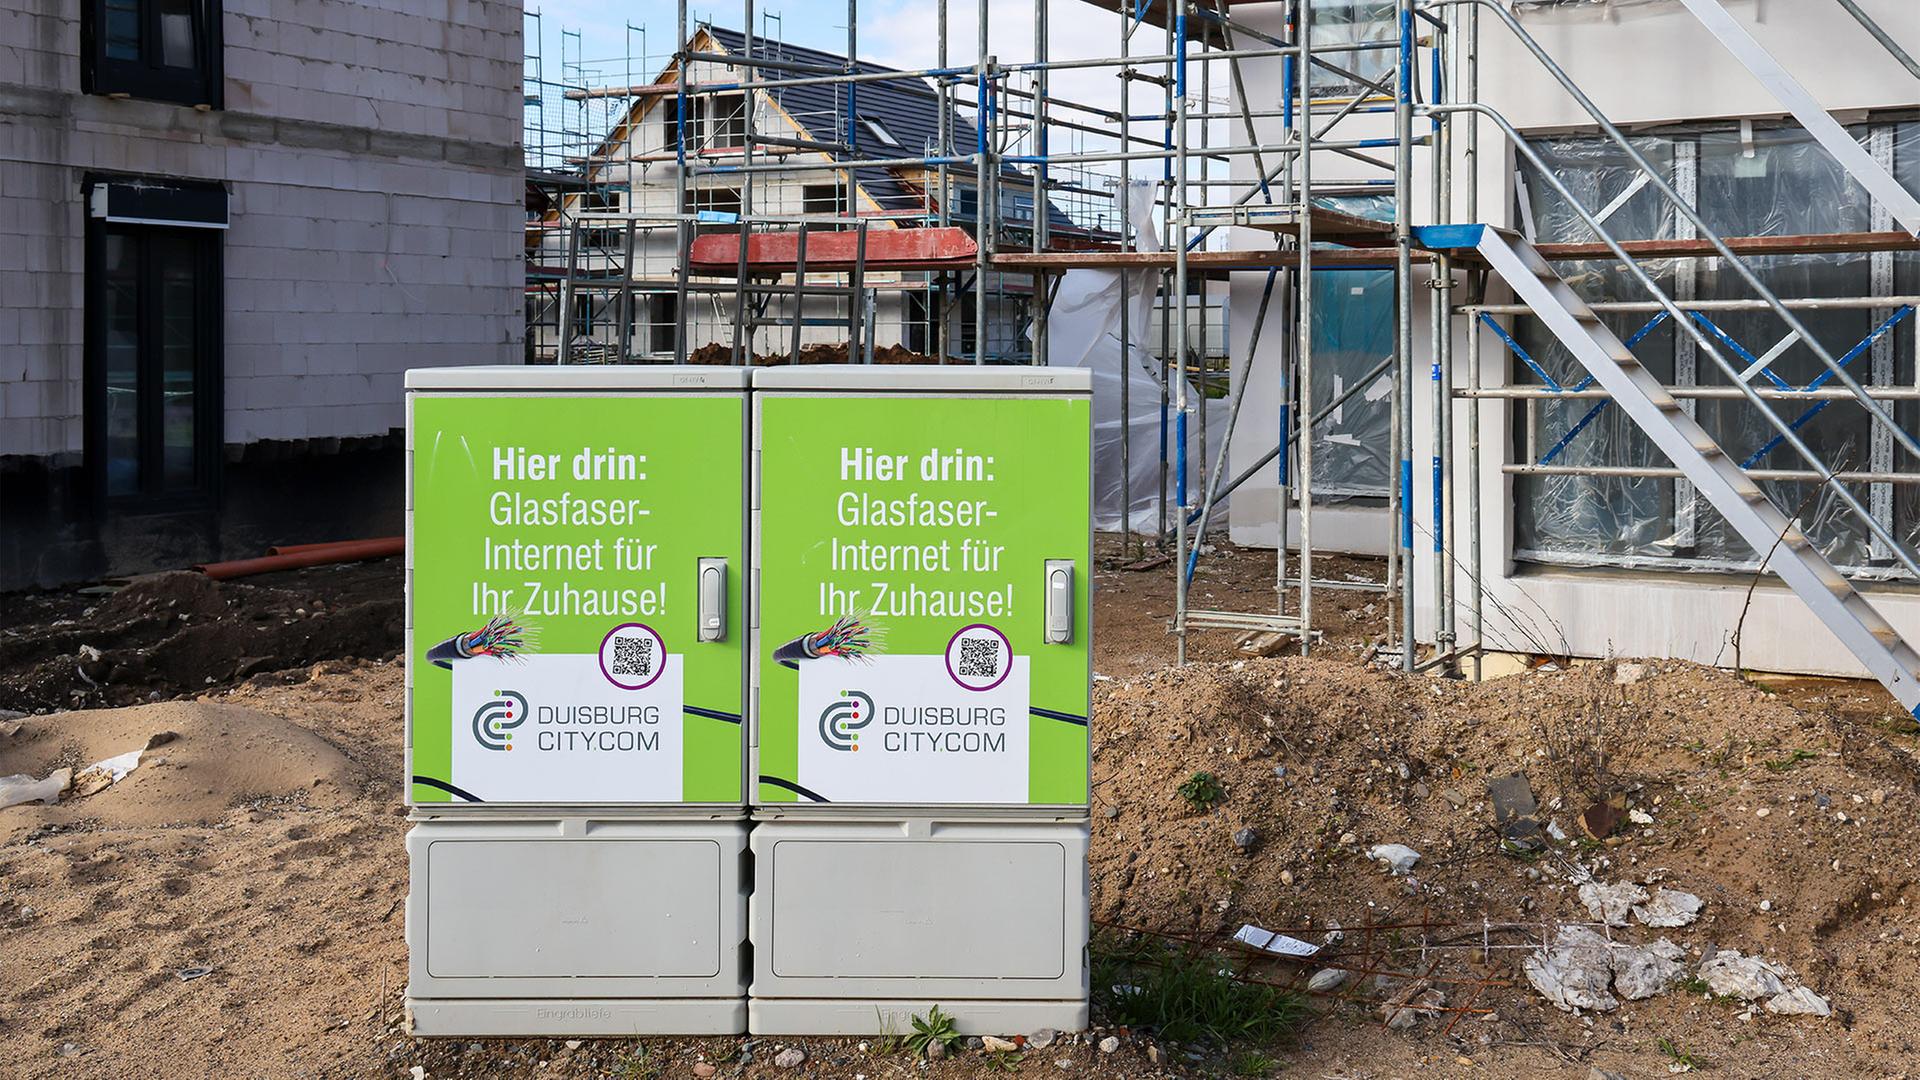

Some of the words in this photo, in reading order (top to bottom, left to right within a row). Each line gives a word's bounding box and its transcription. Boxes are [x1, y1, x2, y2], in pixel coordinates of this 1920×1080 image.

[494, 447, 560, 480] Hier
[573, 447, 647, 480] drin:
[841, 447, 908, 481] Hier
[921, 447, 994, 481] drin:
[490, 492, 650, 525] Glasfaser-
[838, 492, 997, 526] Glasfaser-
[485, 537, 603, 571] Internet
[613, 537, 657, 570] für
[832, 538, 950, 571] Internet
[960, 539, 1004, 571] für
[473, 582, 514, 615] Ihr
[523, 582, 666, 616] Zuhause!
[820, 582, 860, 616] Ihr
[870, 582, 1012, 617] Zuhause!
[538, 706, 660, 724] DUISBURG
[884, 707, 1006, 726] DUISBURG
[538, 731, 659, 751] CITY.COM
[884, 732, 1005, 752] CITY.COM
